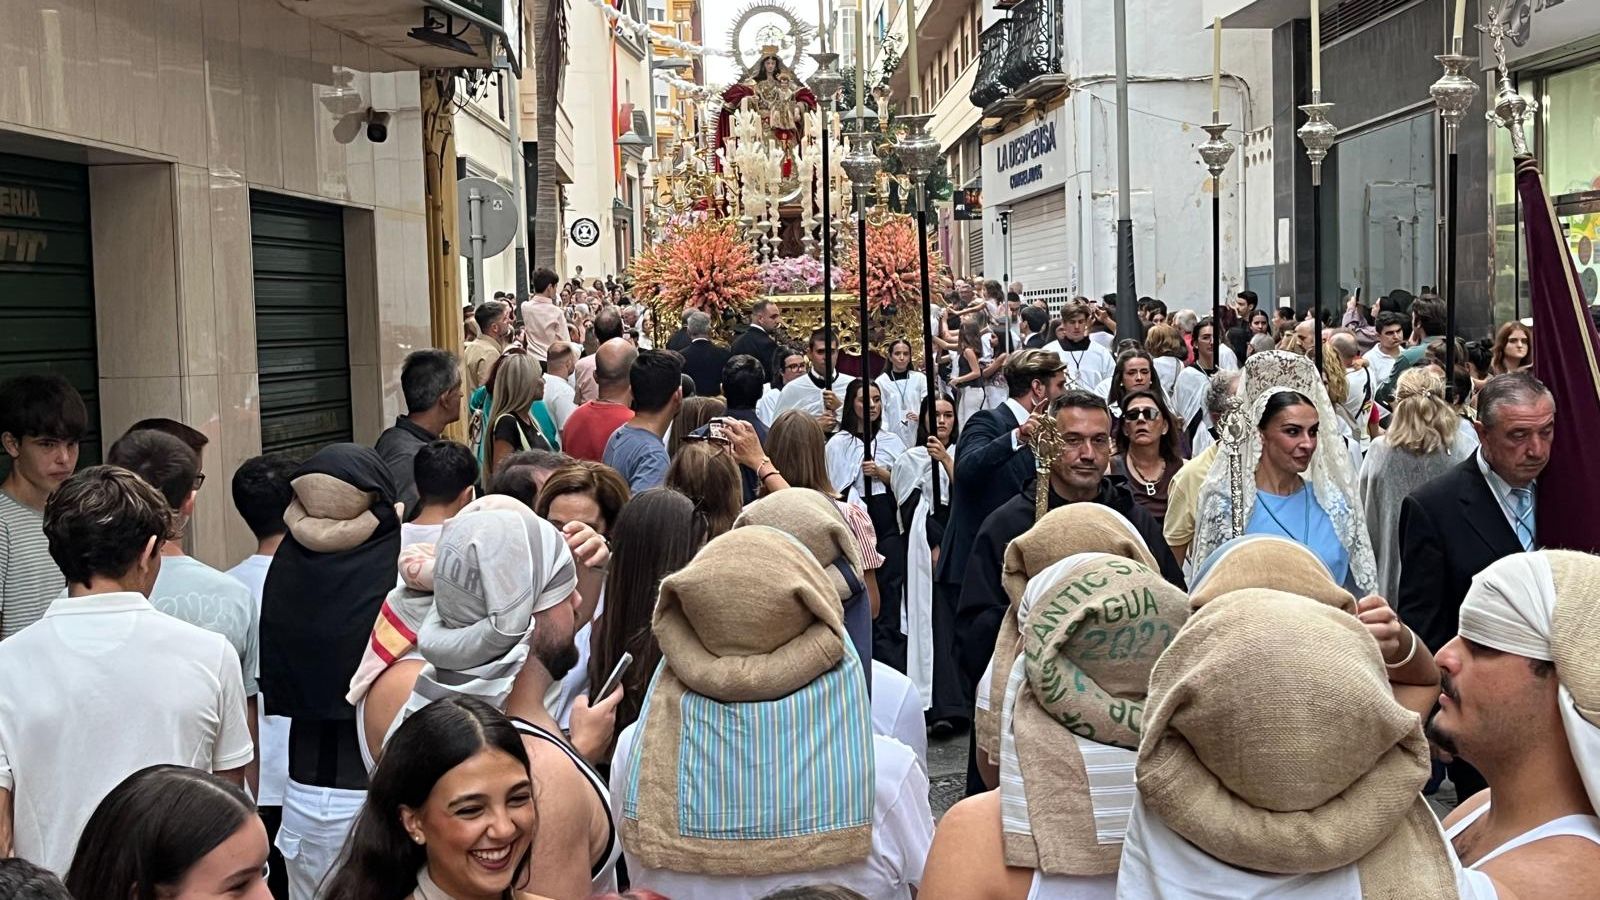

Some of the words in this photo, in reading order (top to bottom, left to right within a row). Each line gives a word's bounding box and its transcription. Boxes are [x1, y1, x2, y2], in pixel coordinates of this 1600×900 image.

[997, 144, 1008, 173] LA
[1009, 122, 1056, 168] DESPENSA
[1024, 570, 1109, 662] LANTIC
